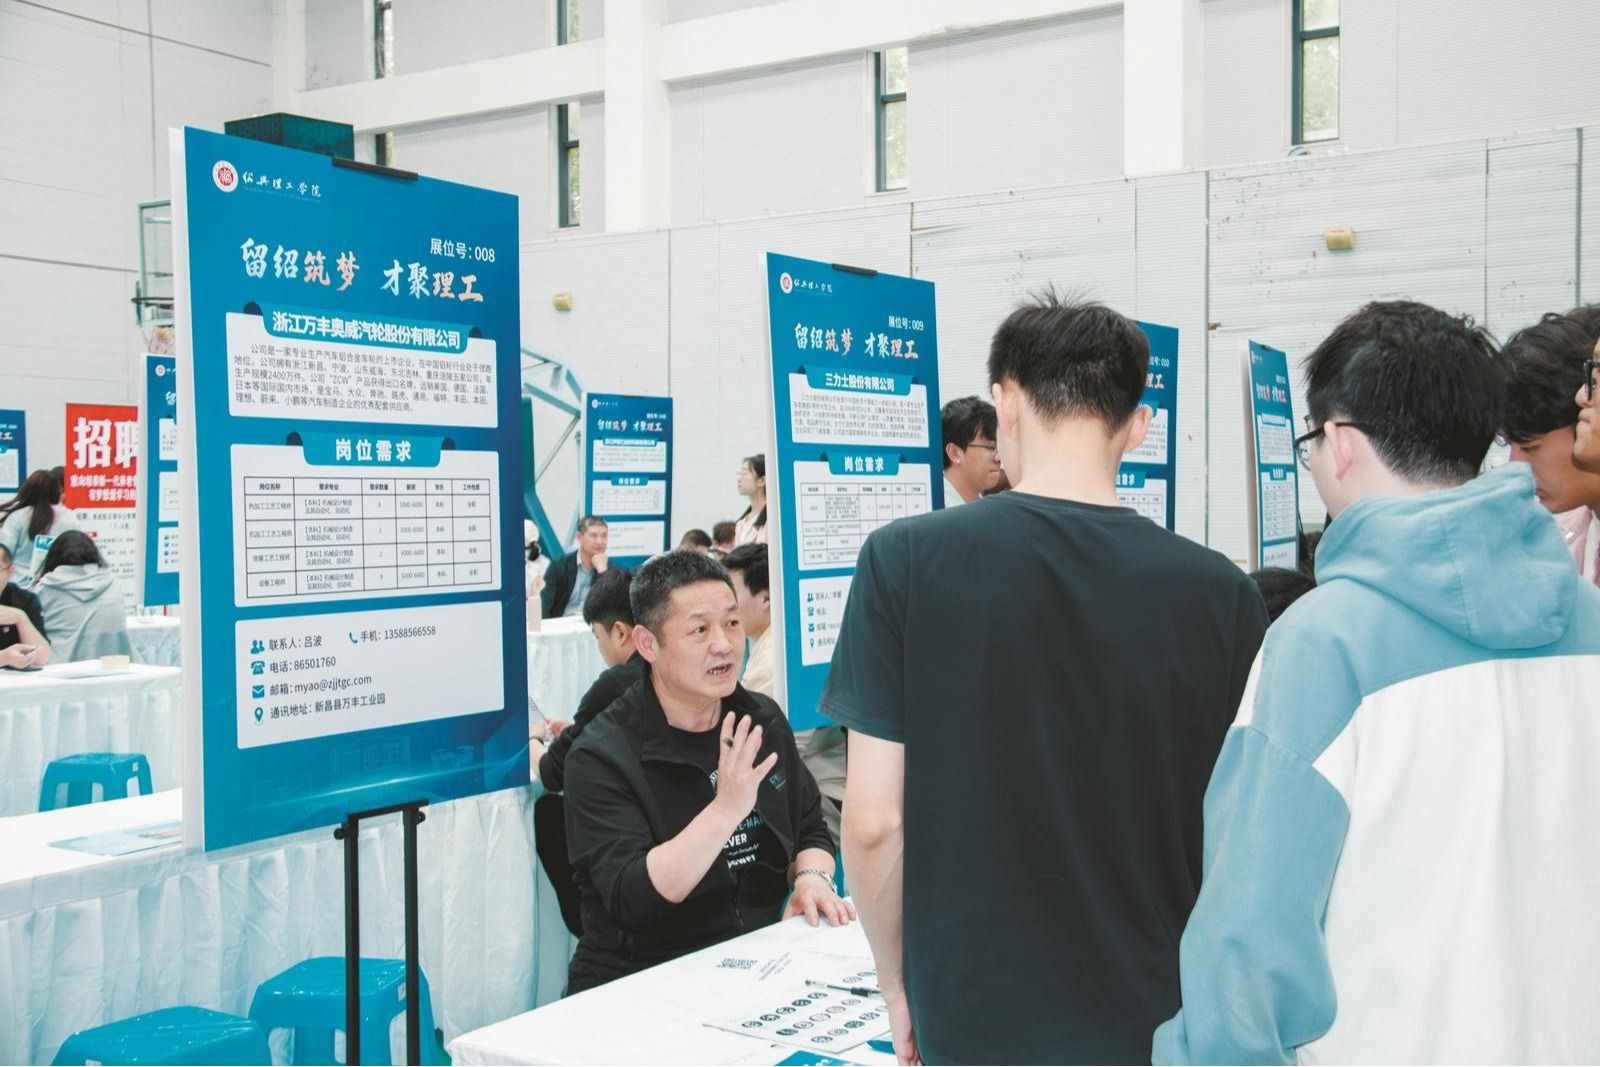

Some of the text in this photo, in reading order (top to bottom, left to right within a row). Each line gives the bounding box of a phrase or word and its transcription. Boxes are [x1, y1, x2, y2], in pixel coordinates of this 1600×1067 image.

[239, 237, 484, 303] 留绍筑梦 才聚理工
[272, 311, 461, 350] 浙江万丰奥威汽轮股份有限公司
[794, 322, 919, 360] 留绍筑梦 才聚理工
[825, 372, 895, 392] 三力士股份有限公司
[335, 438, 412, 463] 岗位需求
[844, 456, 885, 473] 岗位需求
[269, 635, 322, 652] 联系人：吕波
[360, 625, 436, 642] 手机：13588566558
[269, 656, 337, 674] 电话：86501760
[270, 693, 386, 720] 通讯地址：新昌县万丰工业园
